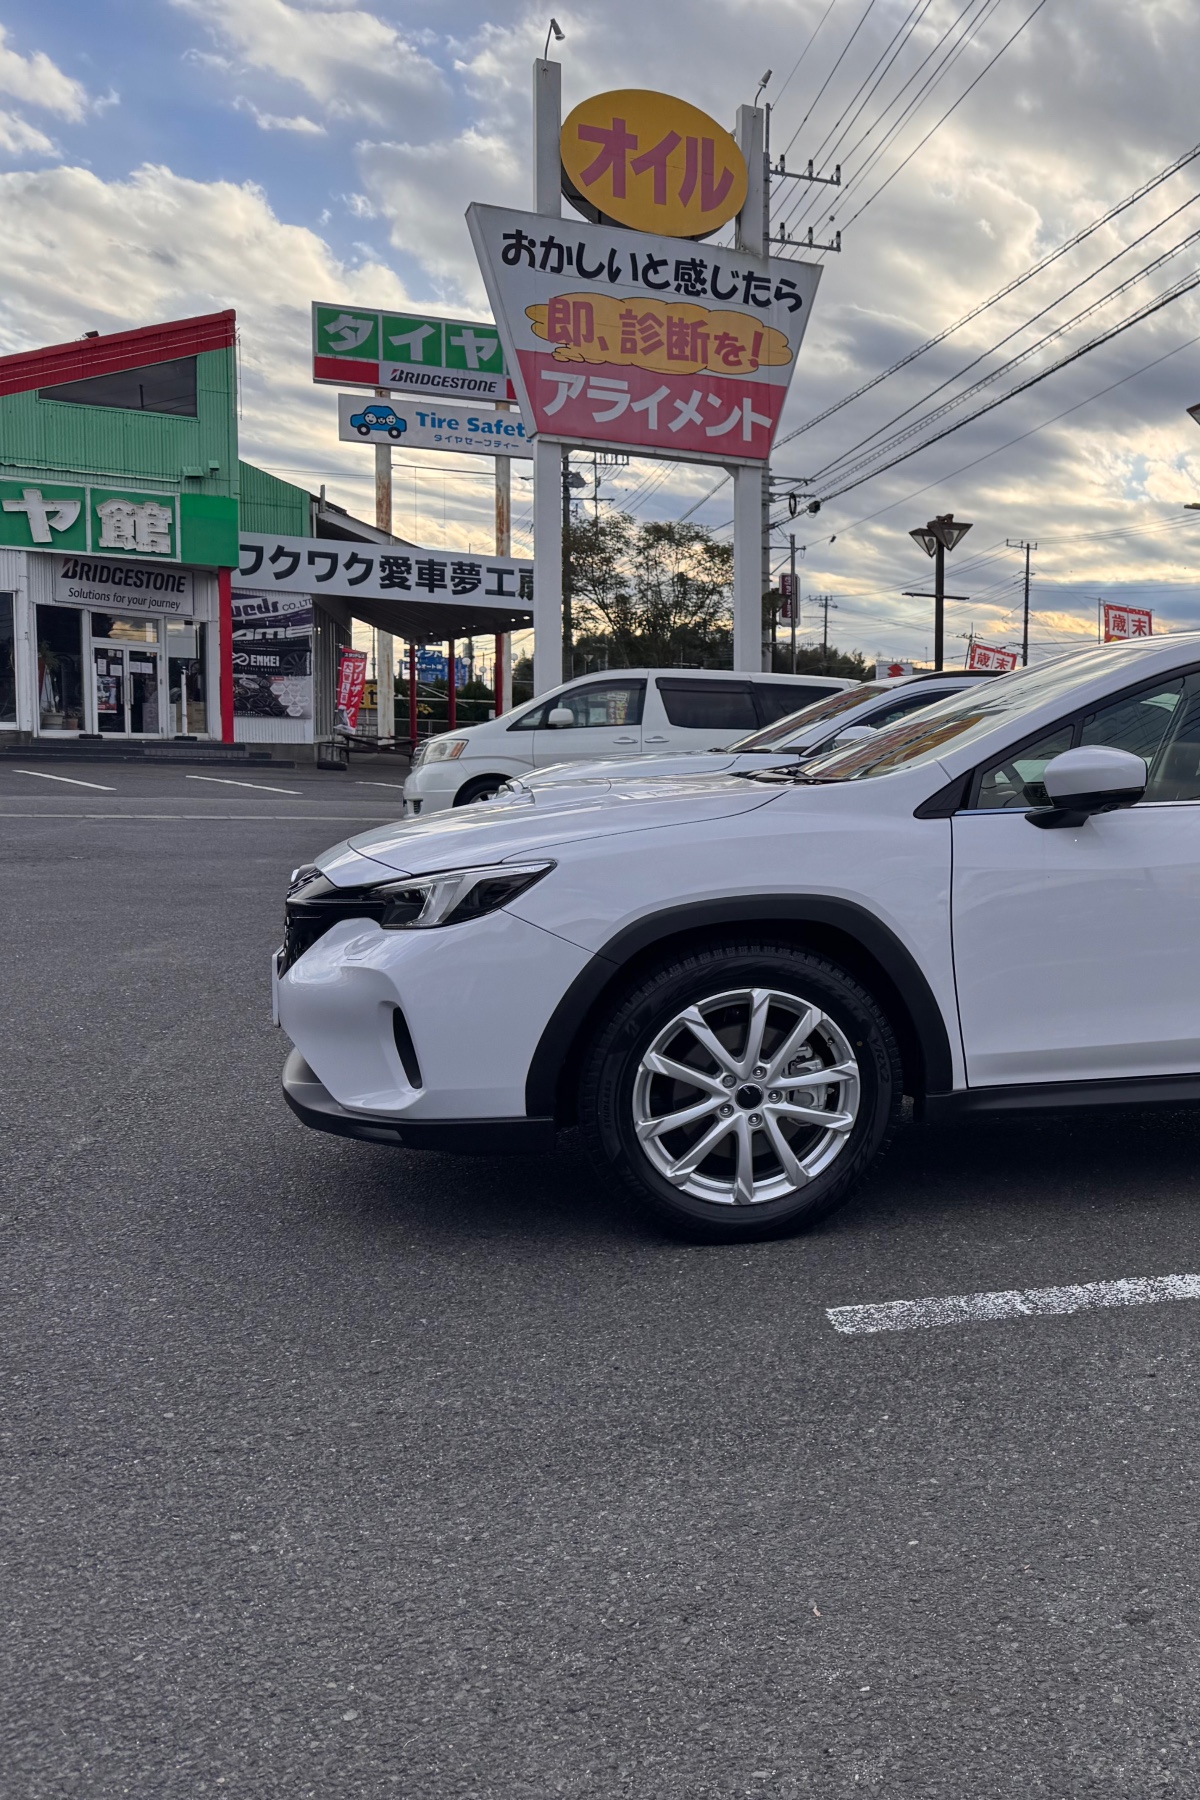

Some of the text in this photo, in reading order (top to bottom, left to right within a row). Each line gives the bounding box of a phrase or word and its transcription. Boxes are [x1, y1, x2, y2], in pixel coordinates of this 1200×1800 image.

[577, 117, 735, 212] オイル
[501, 229, 804, 313] おかしいと感じたら
[324, 313, 499, 369] タイヤ
[546, 298, 764, 368] 即、診断を!
[390, 369, 498, 394] BRIDGESTONE
[540, 370, 773, 442] アライメント
[415, 411, 532, 443] Tire Safet
[434, 433, 520, 449] タイヤセーフティー
[60, 558, 187, 594] BRIDGESTONE
[68, 587, 181, 611] Solutions for your journey
[1112, 614, 1149, 637] 歳末
[250, 654, 280, 667] ENKEI
[976, 651, 1010, 671] 歳末
